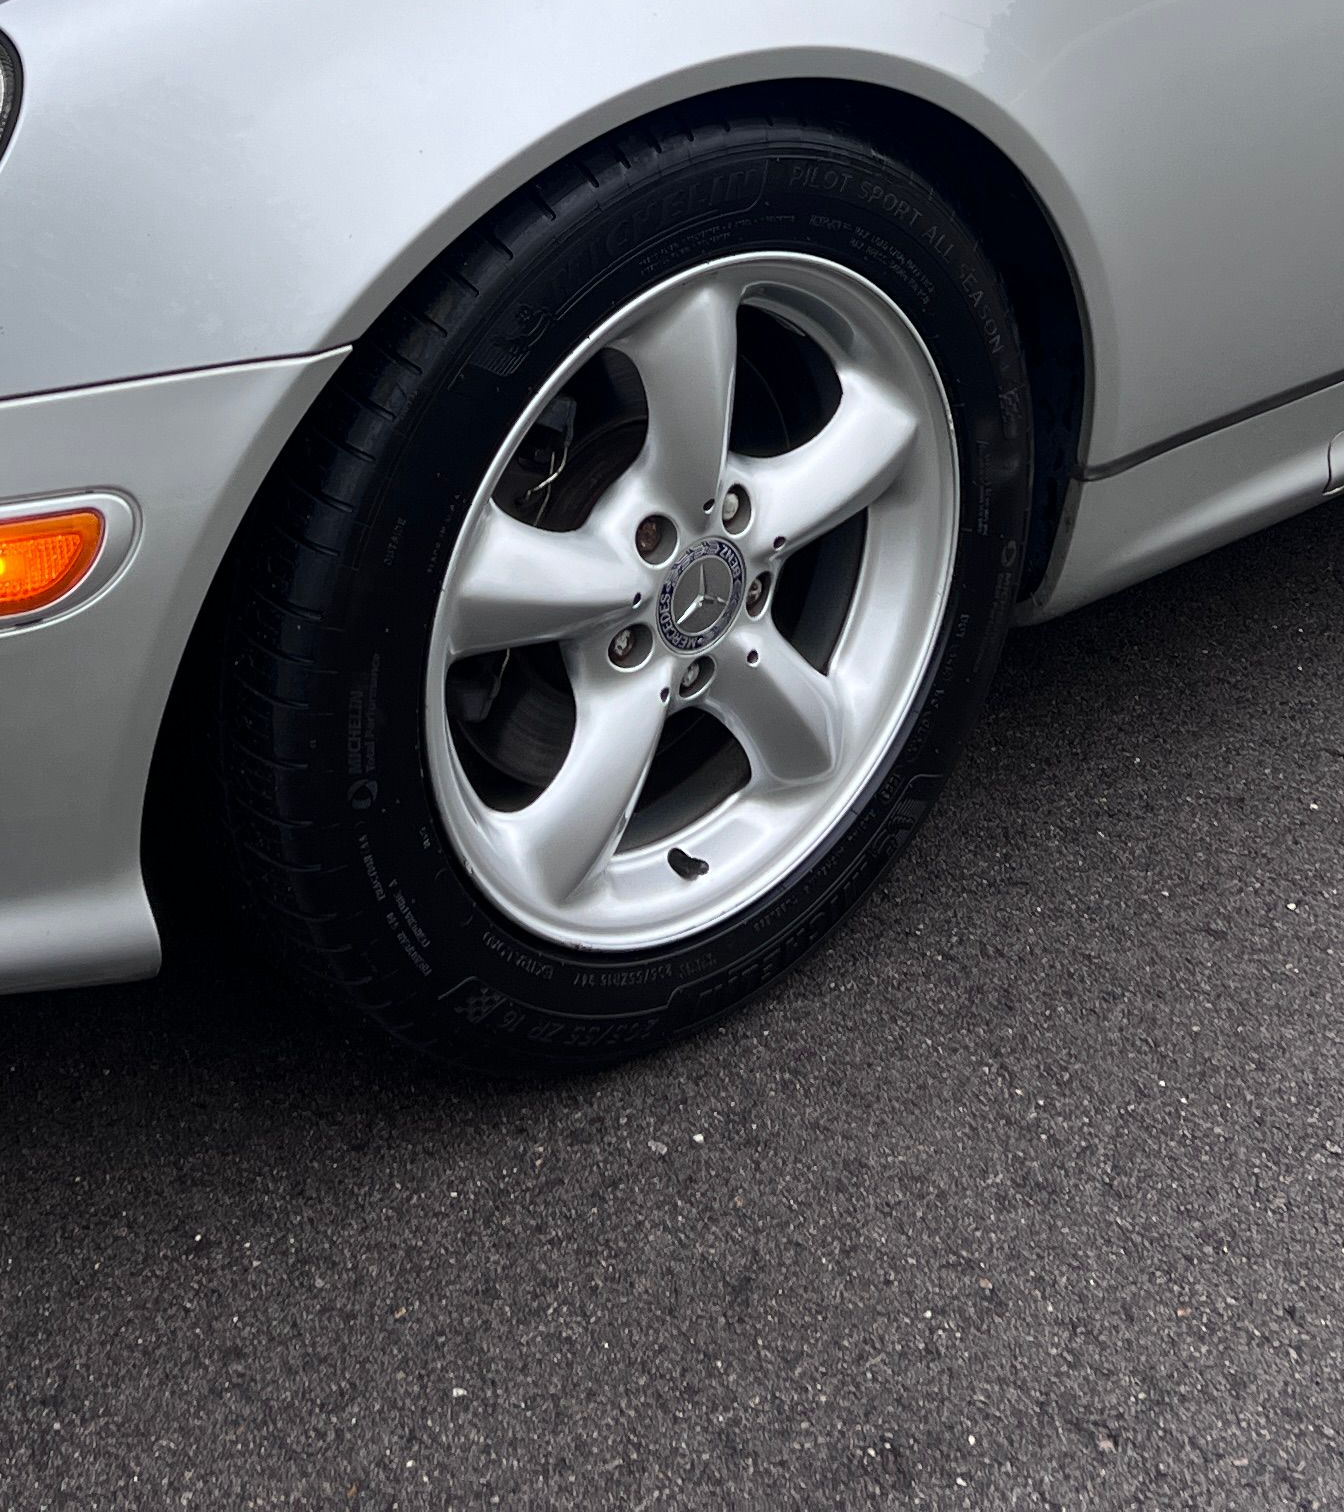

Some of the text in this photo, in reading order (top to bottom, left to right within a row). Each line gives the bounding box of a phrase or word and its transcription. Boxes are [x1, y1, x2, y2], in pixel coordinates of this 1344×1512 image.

[788, 164, 855, 194] PILOT
[857, 178, 924, 228] SPORT
[920, 224, 957, 266] ALL
[958, 261, 1008, 356] SEASON
[659, 543, 743, 650] MERCEDES BENZ
[347, 688, 364, 776] MICHELIN
